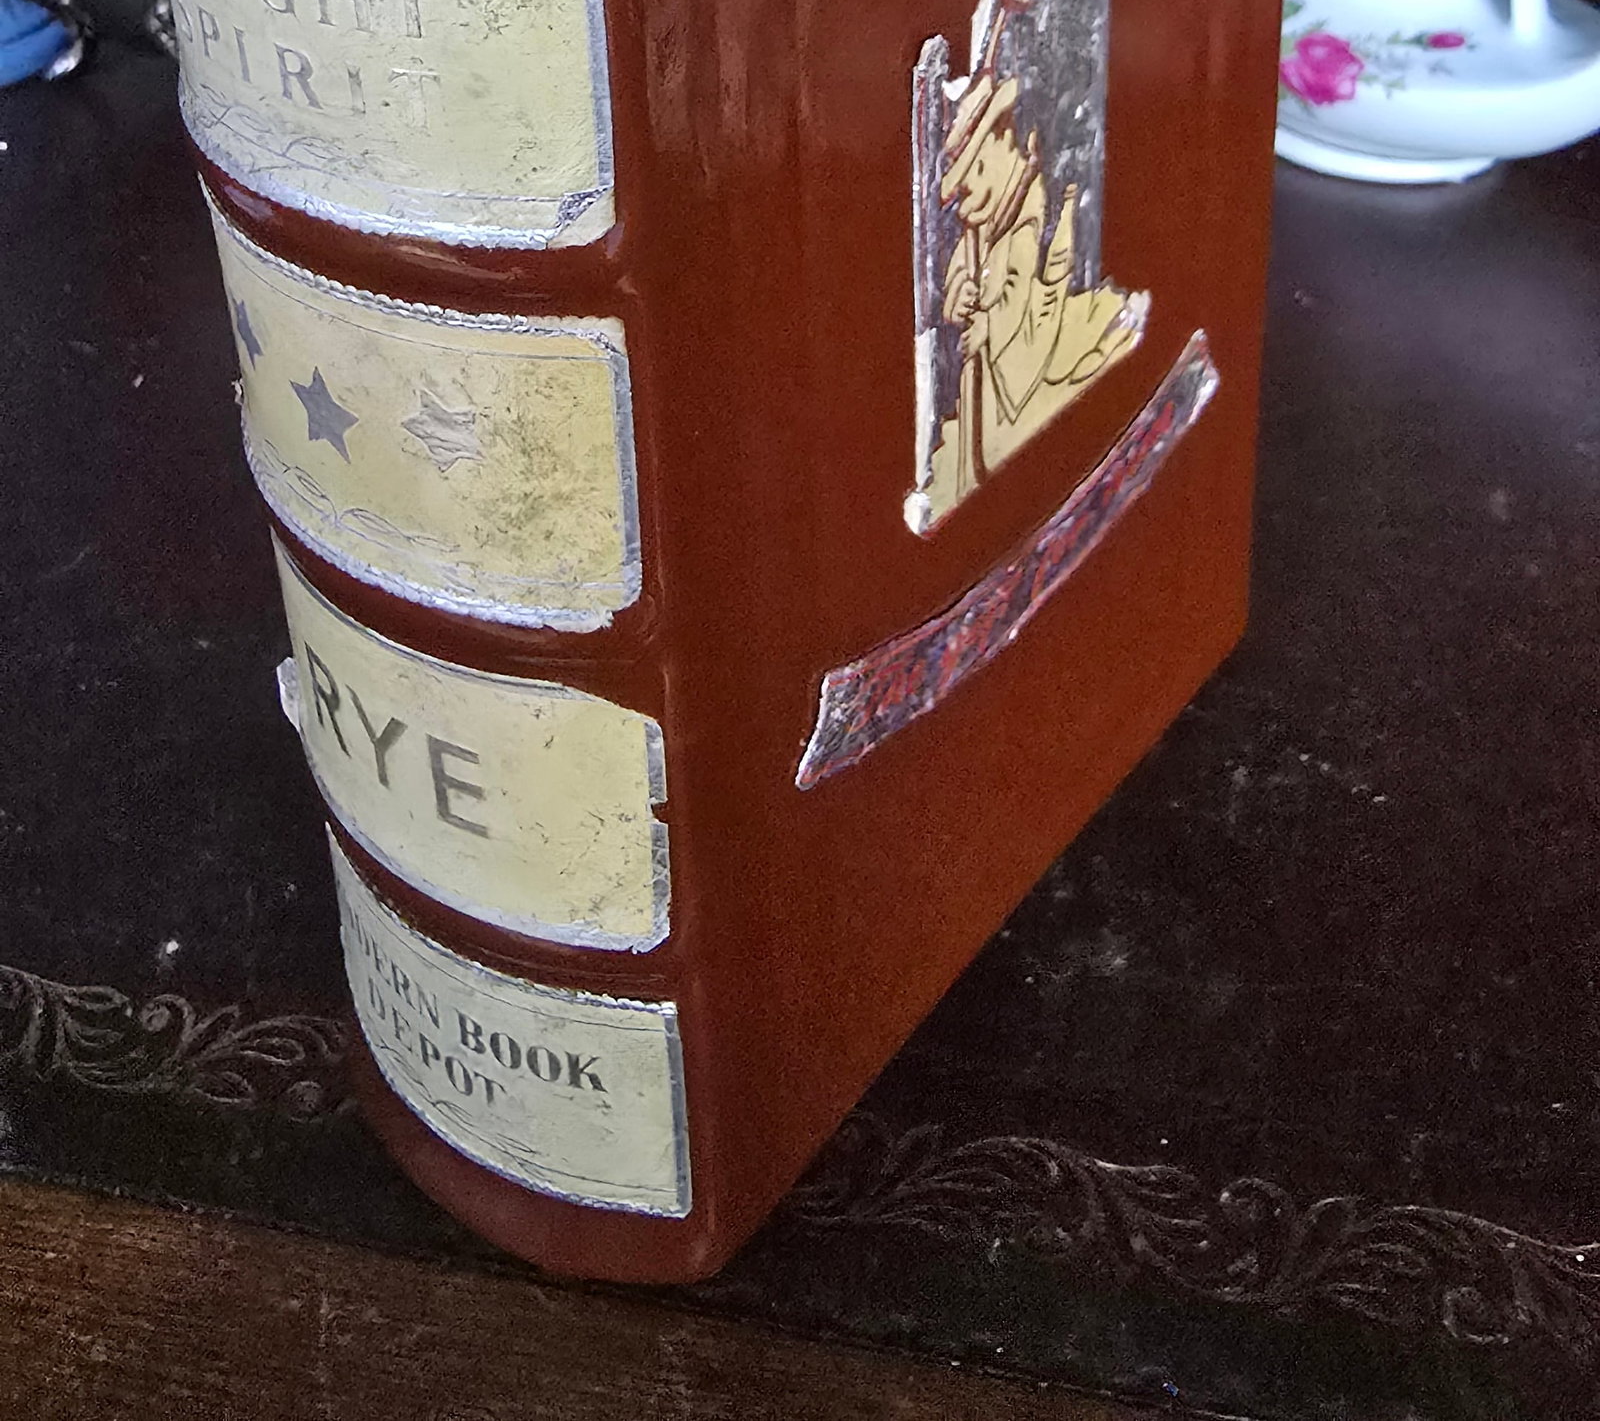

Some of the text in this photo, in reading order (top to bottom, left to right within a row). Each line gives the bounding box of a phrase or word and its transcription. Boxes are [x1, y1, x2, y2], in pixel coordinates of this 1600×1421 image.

[304, 641, 489, 839] RYE
[367, 976, 508, 1106] DEPOT
[454, 1006, 608, 1094] BOOK
